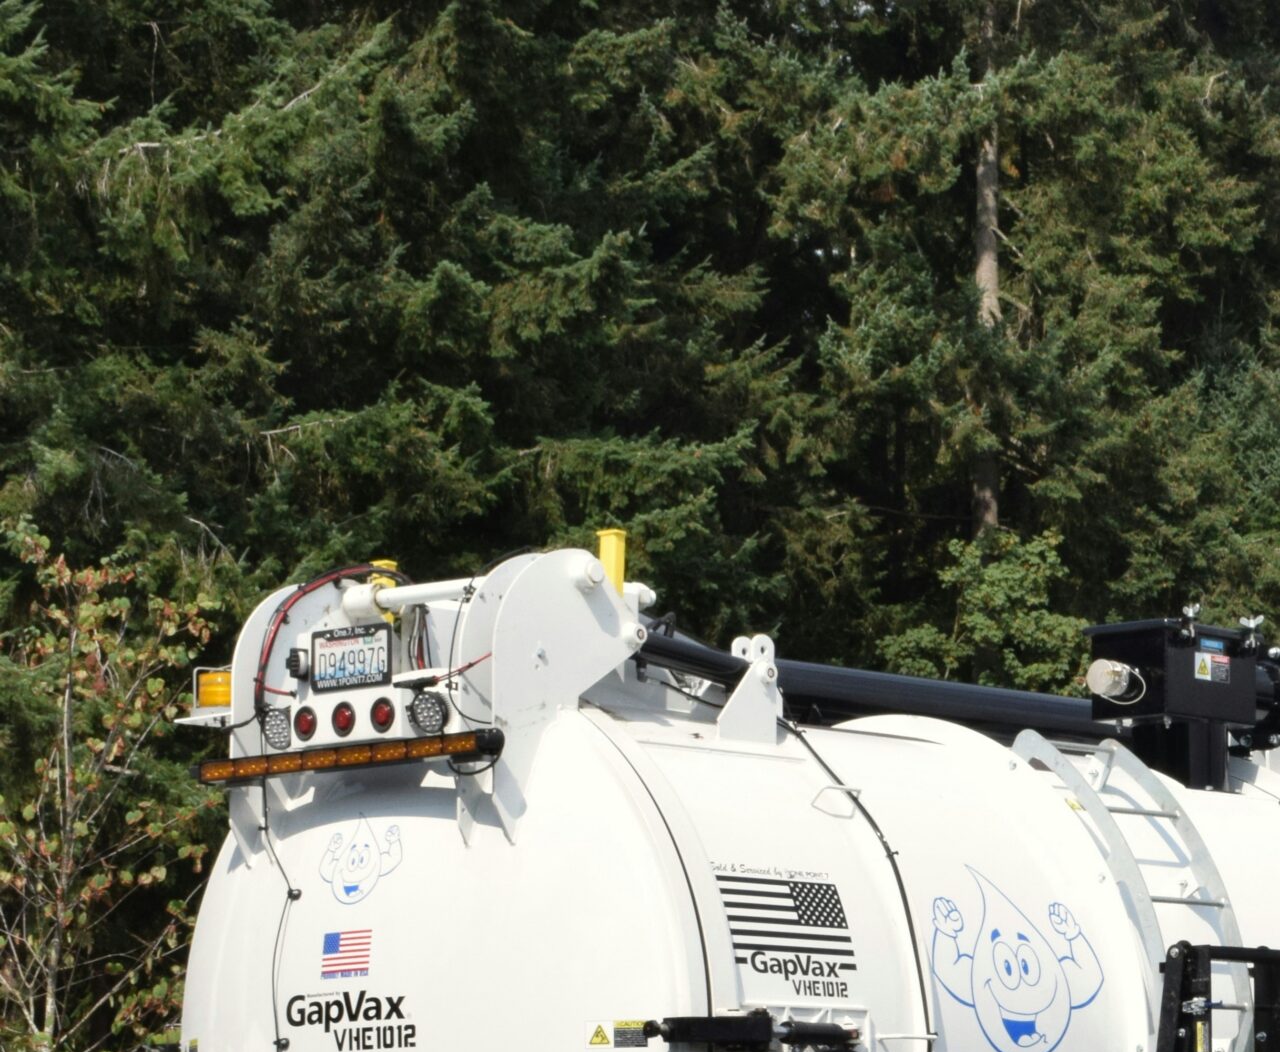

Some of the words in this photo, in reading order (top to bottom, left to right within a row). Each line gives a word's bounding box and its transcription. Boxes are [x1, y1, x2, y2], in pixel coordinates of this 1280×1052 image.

[317, 673, 383, 689] WWW.1POINT7.COM
[750, 951, 840, 981] GapVax
[792, 979, 848, 998] VHE1012
[286, 990, 405, 1033] GapVax
[334, 1024, 416, 1051] VHE1012
